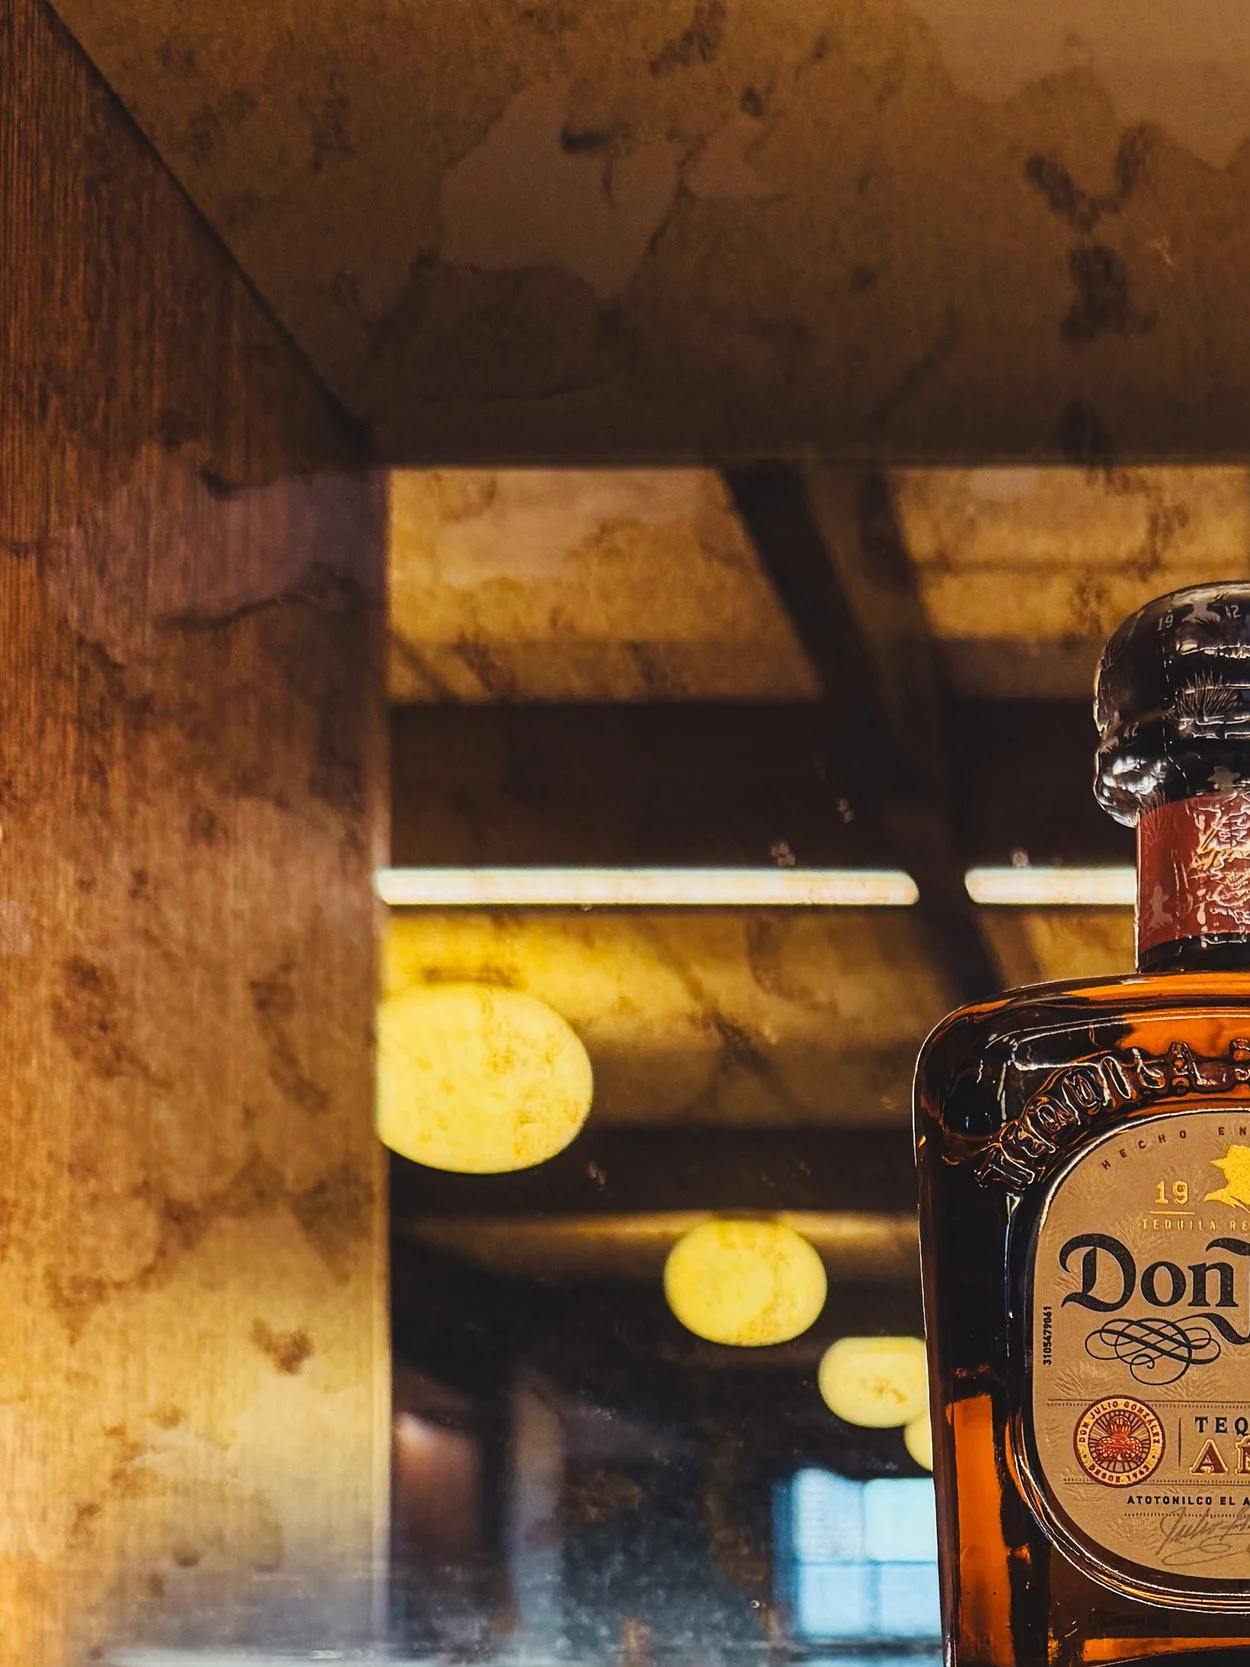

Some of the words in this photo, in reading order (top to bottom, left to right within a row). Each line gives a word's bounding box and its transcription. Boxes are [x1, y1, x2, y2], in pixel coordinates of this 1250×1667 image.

[1101, 1129, 1187, 1170] HECHO
[1218, 1126, 1247, 1136] EN
[1154, 1180, 1190, 1206] 19
[1141, 1218, 1217, 1231] TEQUILA
[1090, 1401, 1119, 1420] JULIO
[1126, 1495, 1213, 1506] ATOTONILCO
[1219, 1496, 1236, 1506] EL
